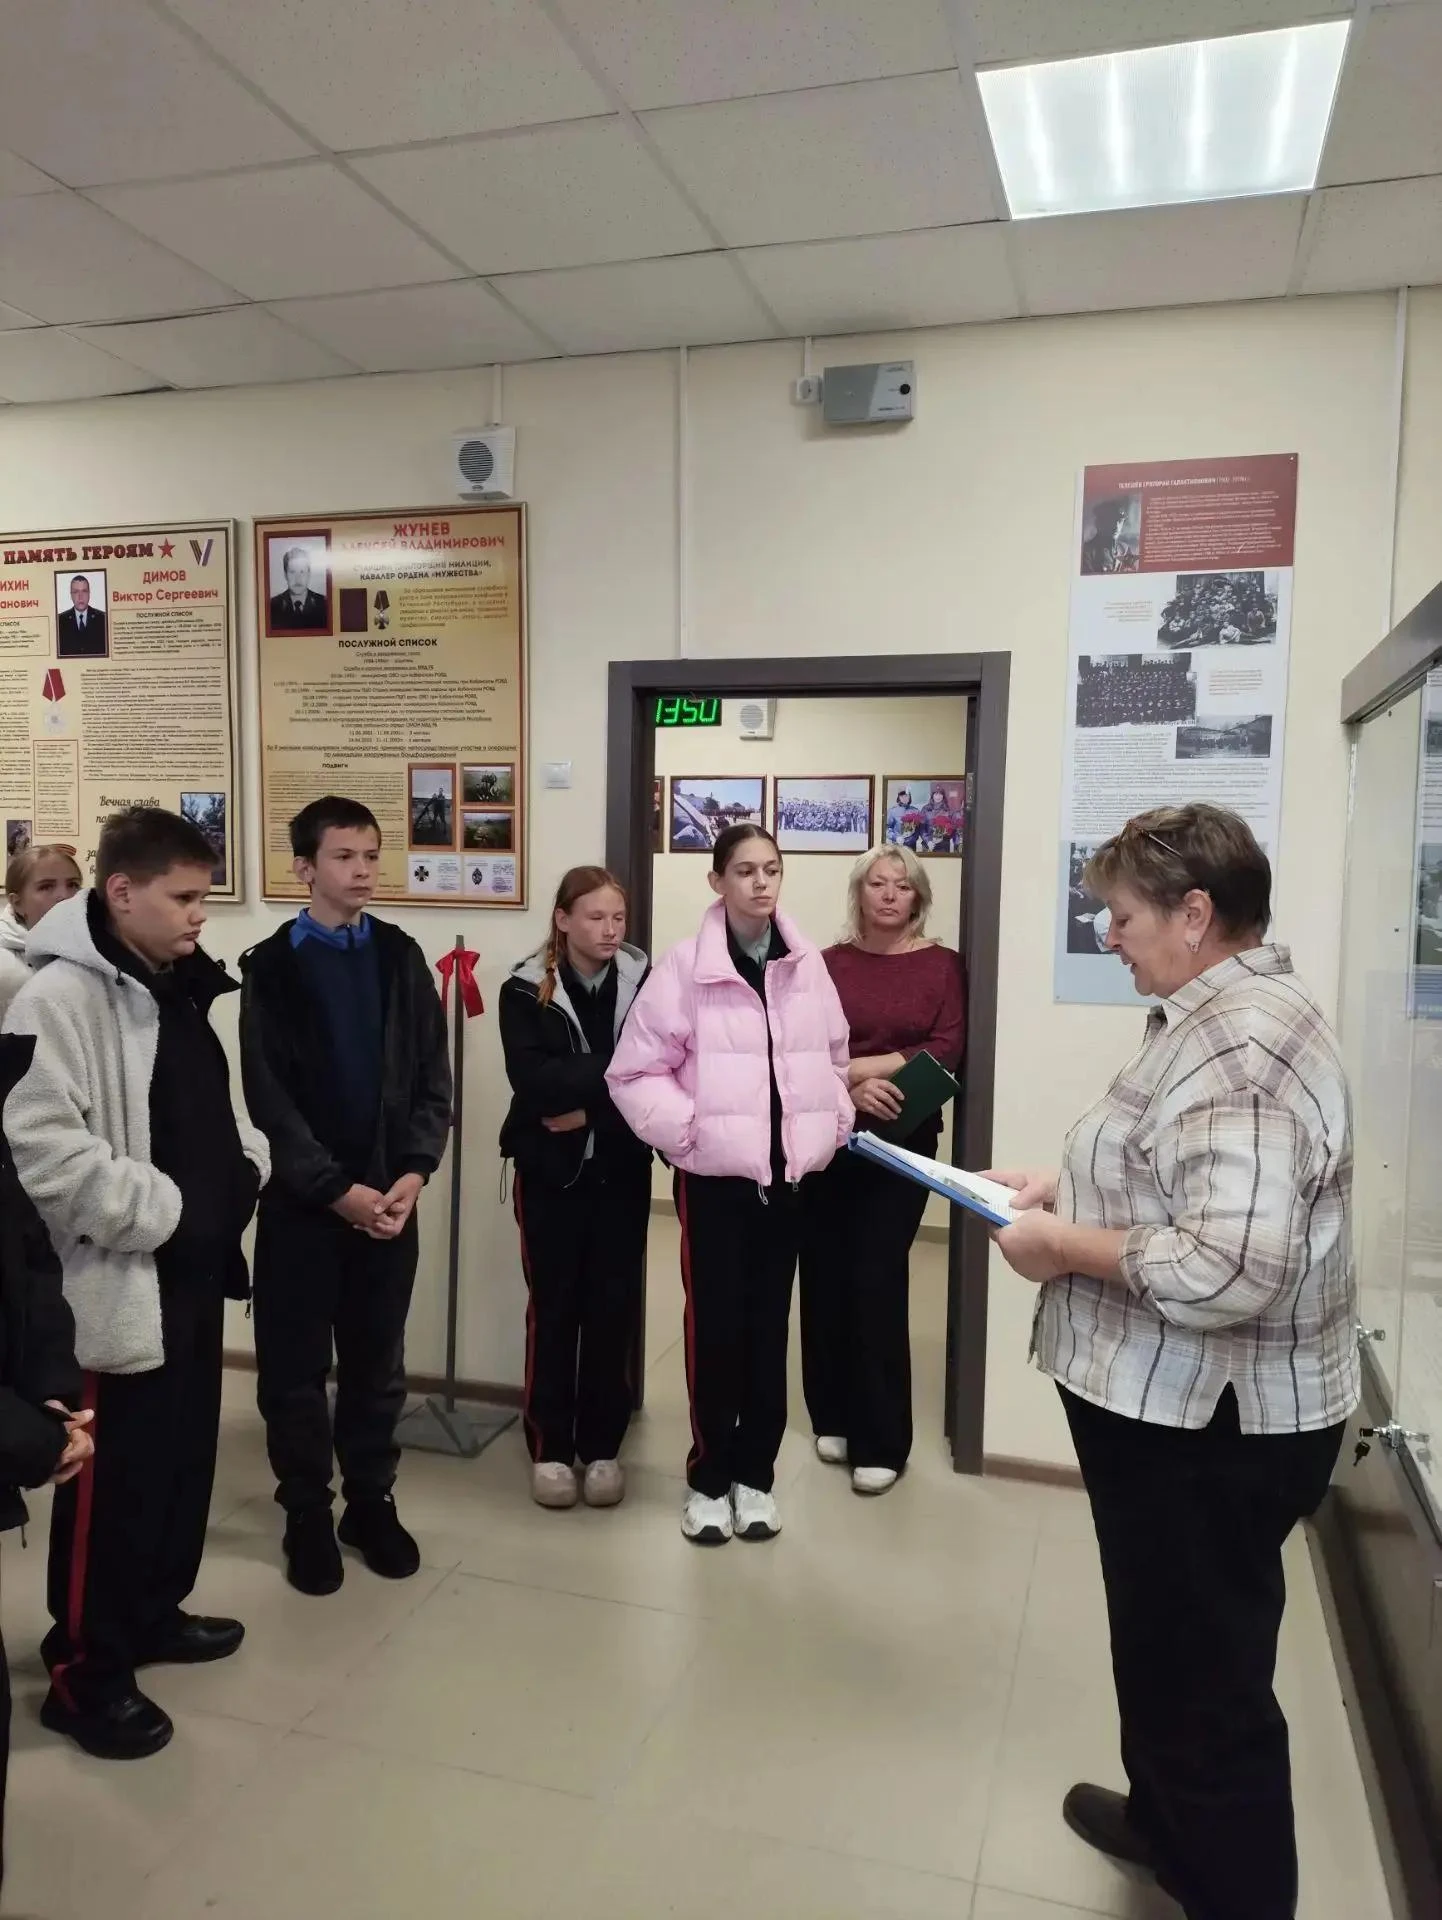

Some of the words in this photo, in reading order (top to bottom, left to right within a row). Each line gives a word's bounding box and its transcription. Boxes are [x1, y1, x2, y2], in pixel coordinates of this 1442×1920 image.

[393, 521, 450, 538] ЖУНЕВ
[401, 536, 505, 551] ВЛАДИМИРОВИЧ
[4, 548, 77, 565] ПАМЯТЬ
[82, 543, 154, 561] ГЕРОЯМ
[448, 559, 492, 569] МИЛИЦИИ,
[142, 570, 187, 584] ДИМОВ
[360, 572, 396, 581] КАВАЛЕР
[397, 571, 429, 580] ОРДЕНА
[431, 569, 483, 579] «МУЖЕСТВА»
[112, 591, 153, 603] Виктор
[156, 589, 218, 603] Сергеевич
[338, 638, 396, 649] ПОСЛУЖНОЙ
[398, 638, 438, 648] СПИСОК
[99, 795, 131, 807] Вечная
[133, 796, 160, 808] слава
